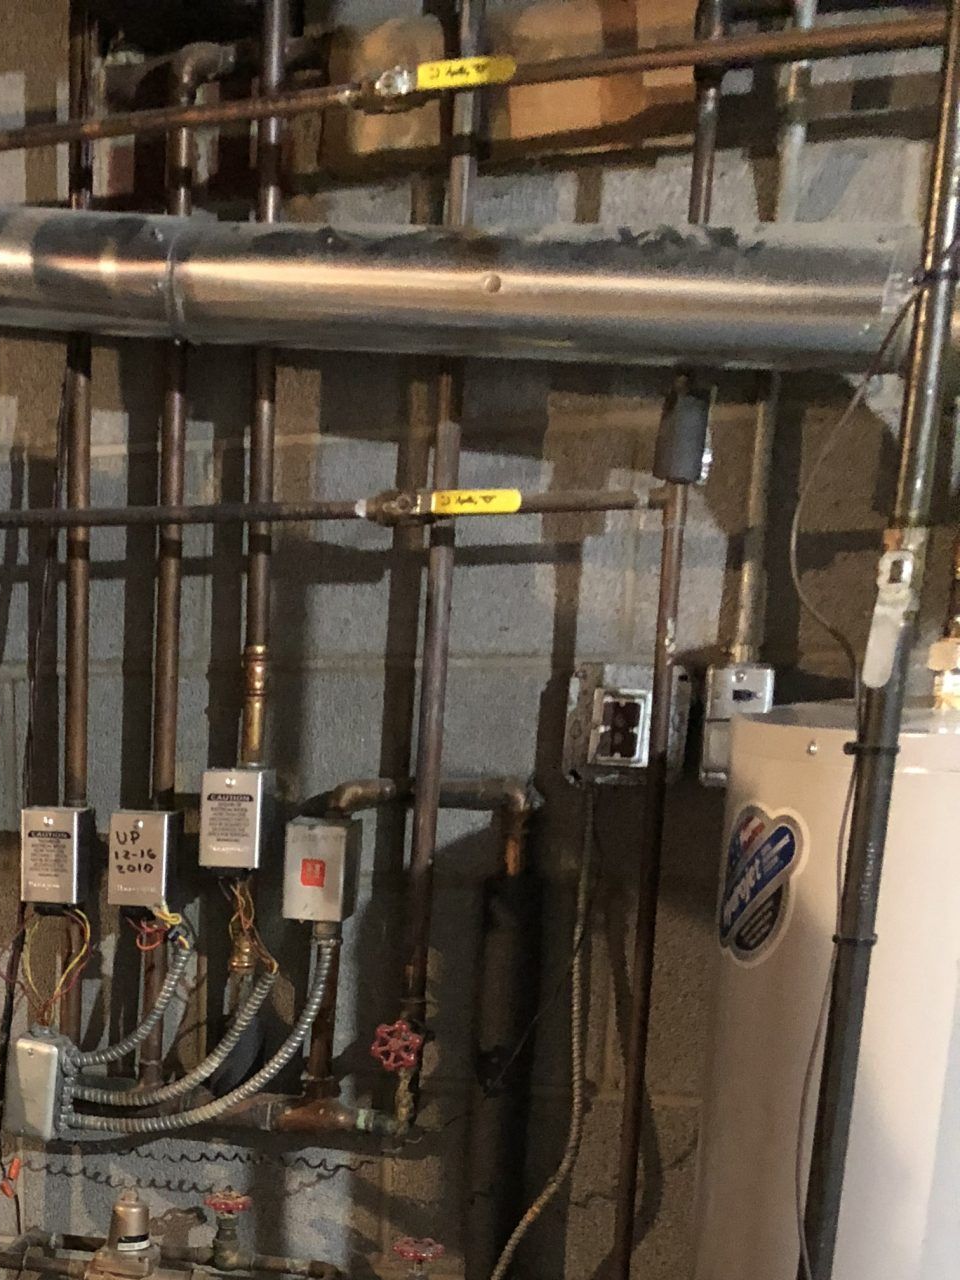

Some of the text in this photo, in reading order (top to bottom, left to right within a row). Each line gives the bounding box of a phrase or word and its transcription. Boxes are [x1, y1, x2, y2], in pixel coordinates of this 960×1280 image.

[115, 830, 140, 845] UP
[114, 848, 157, 860] 12-16
[116, 863, 154, 874] 2010
